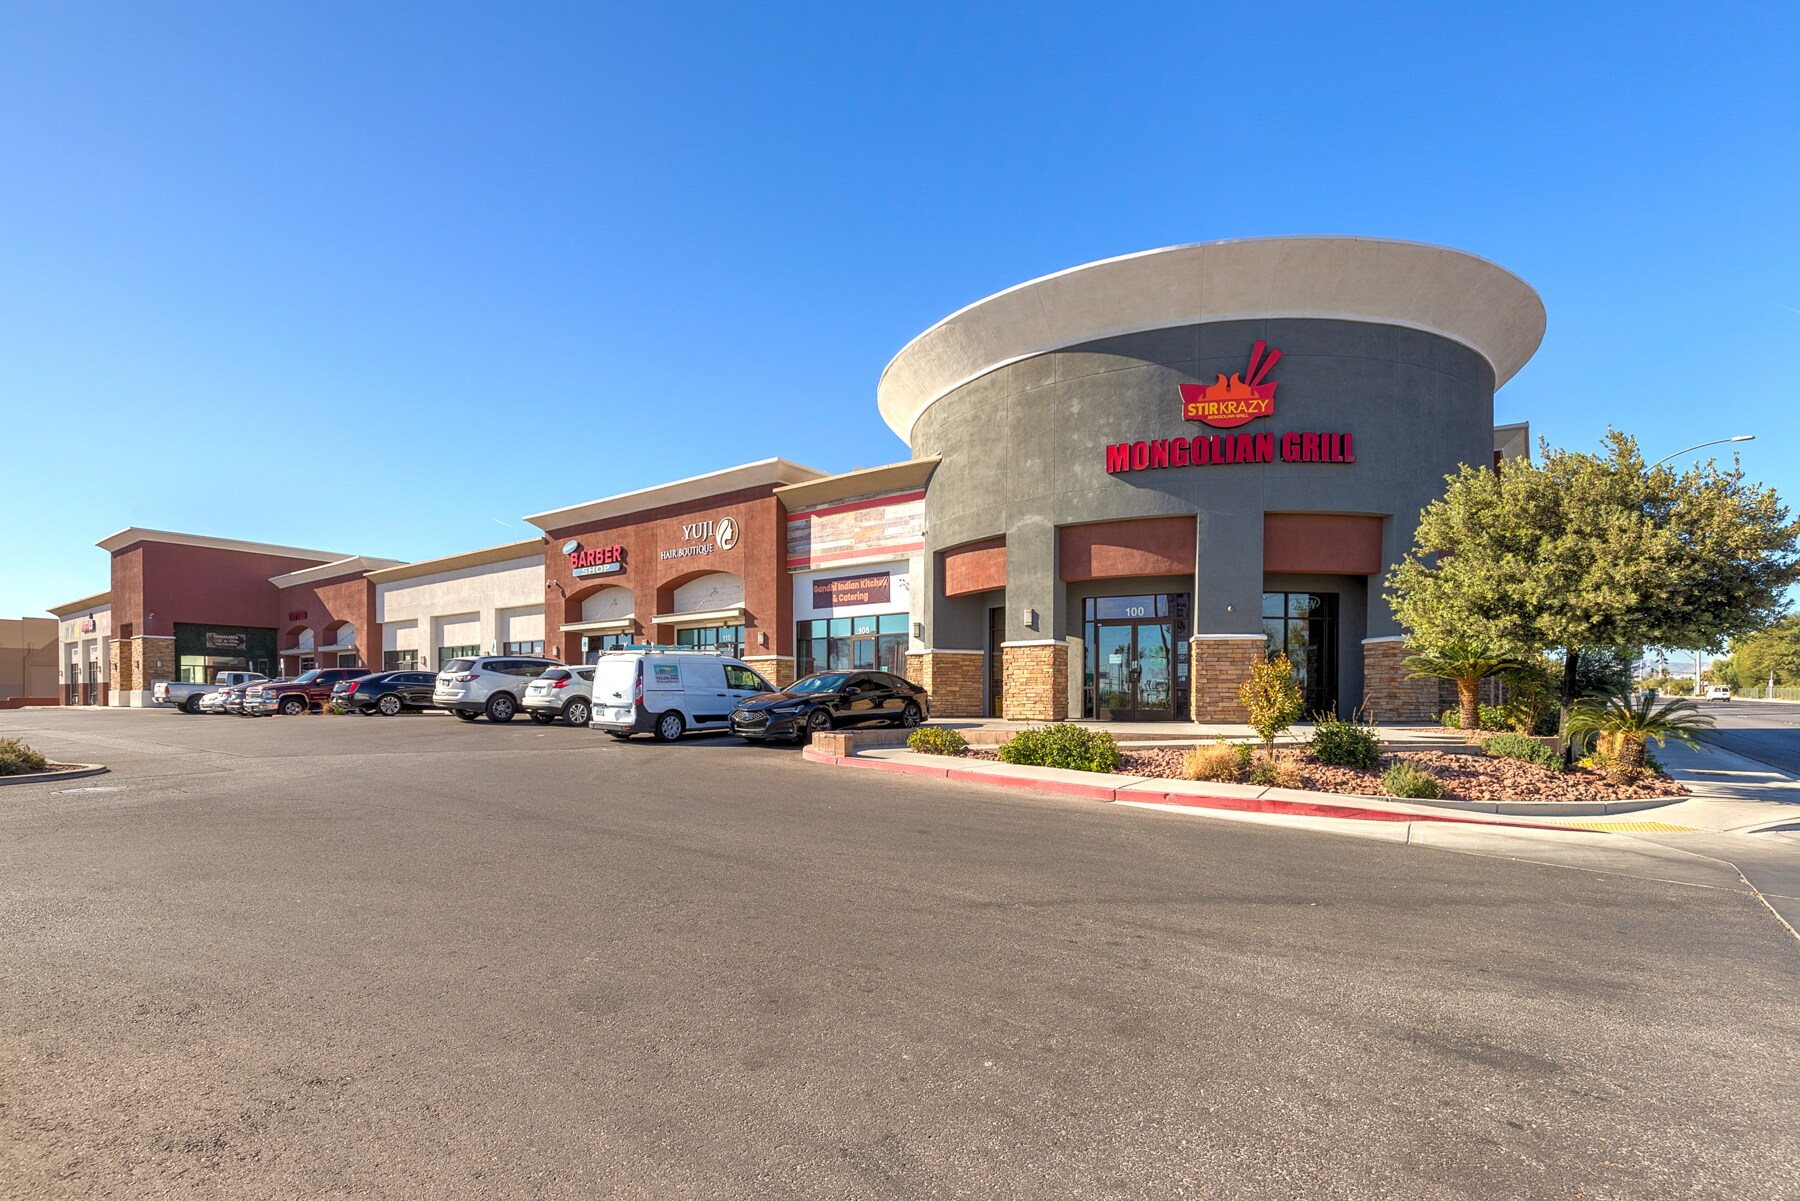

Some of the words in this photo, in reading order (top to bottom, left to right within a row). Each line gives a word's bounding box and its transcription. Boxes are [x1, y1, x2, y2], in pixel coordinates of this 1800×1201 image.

[1106, 432, 1275, 474] MONGOLIAN
[1280, 431, 1356, 463] GRILL
[682, 520, 714, 542] YUJI
[569, 544, 622, 569] BARBER
[660, 549, 678, 560] HAIR
[679, 543, 715, 558] BOUTIQUE
[581, 564, 610, 576] SHOP
[813, 581, 838, 593] Gandhi
[838, 580, 860, 591] Indian
[832, 595, 838, 603] &
[838, 591, 869, 602] Catering
[1290, 599, 1317, 610] OPEN
[1125, 606, 1145, 617] 100
[857, 626, 870, 635] 105
[722, 634, 732, 642] 110
